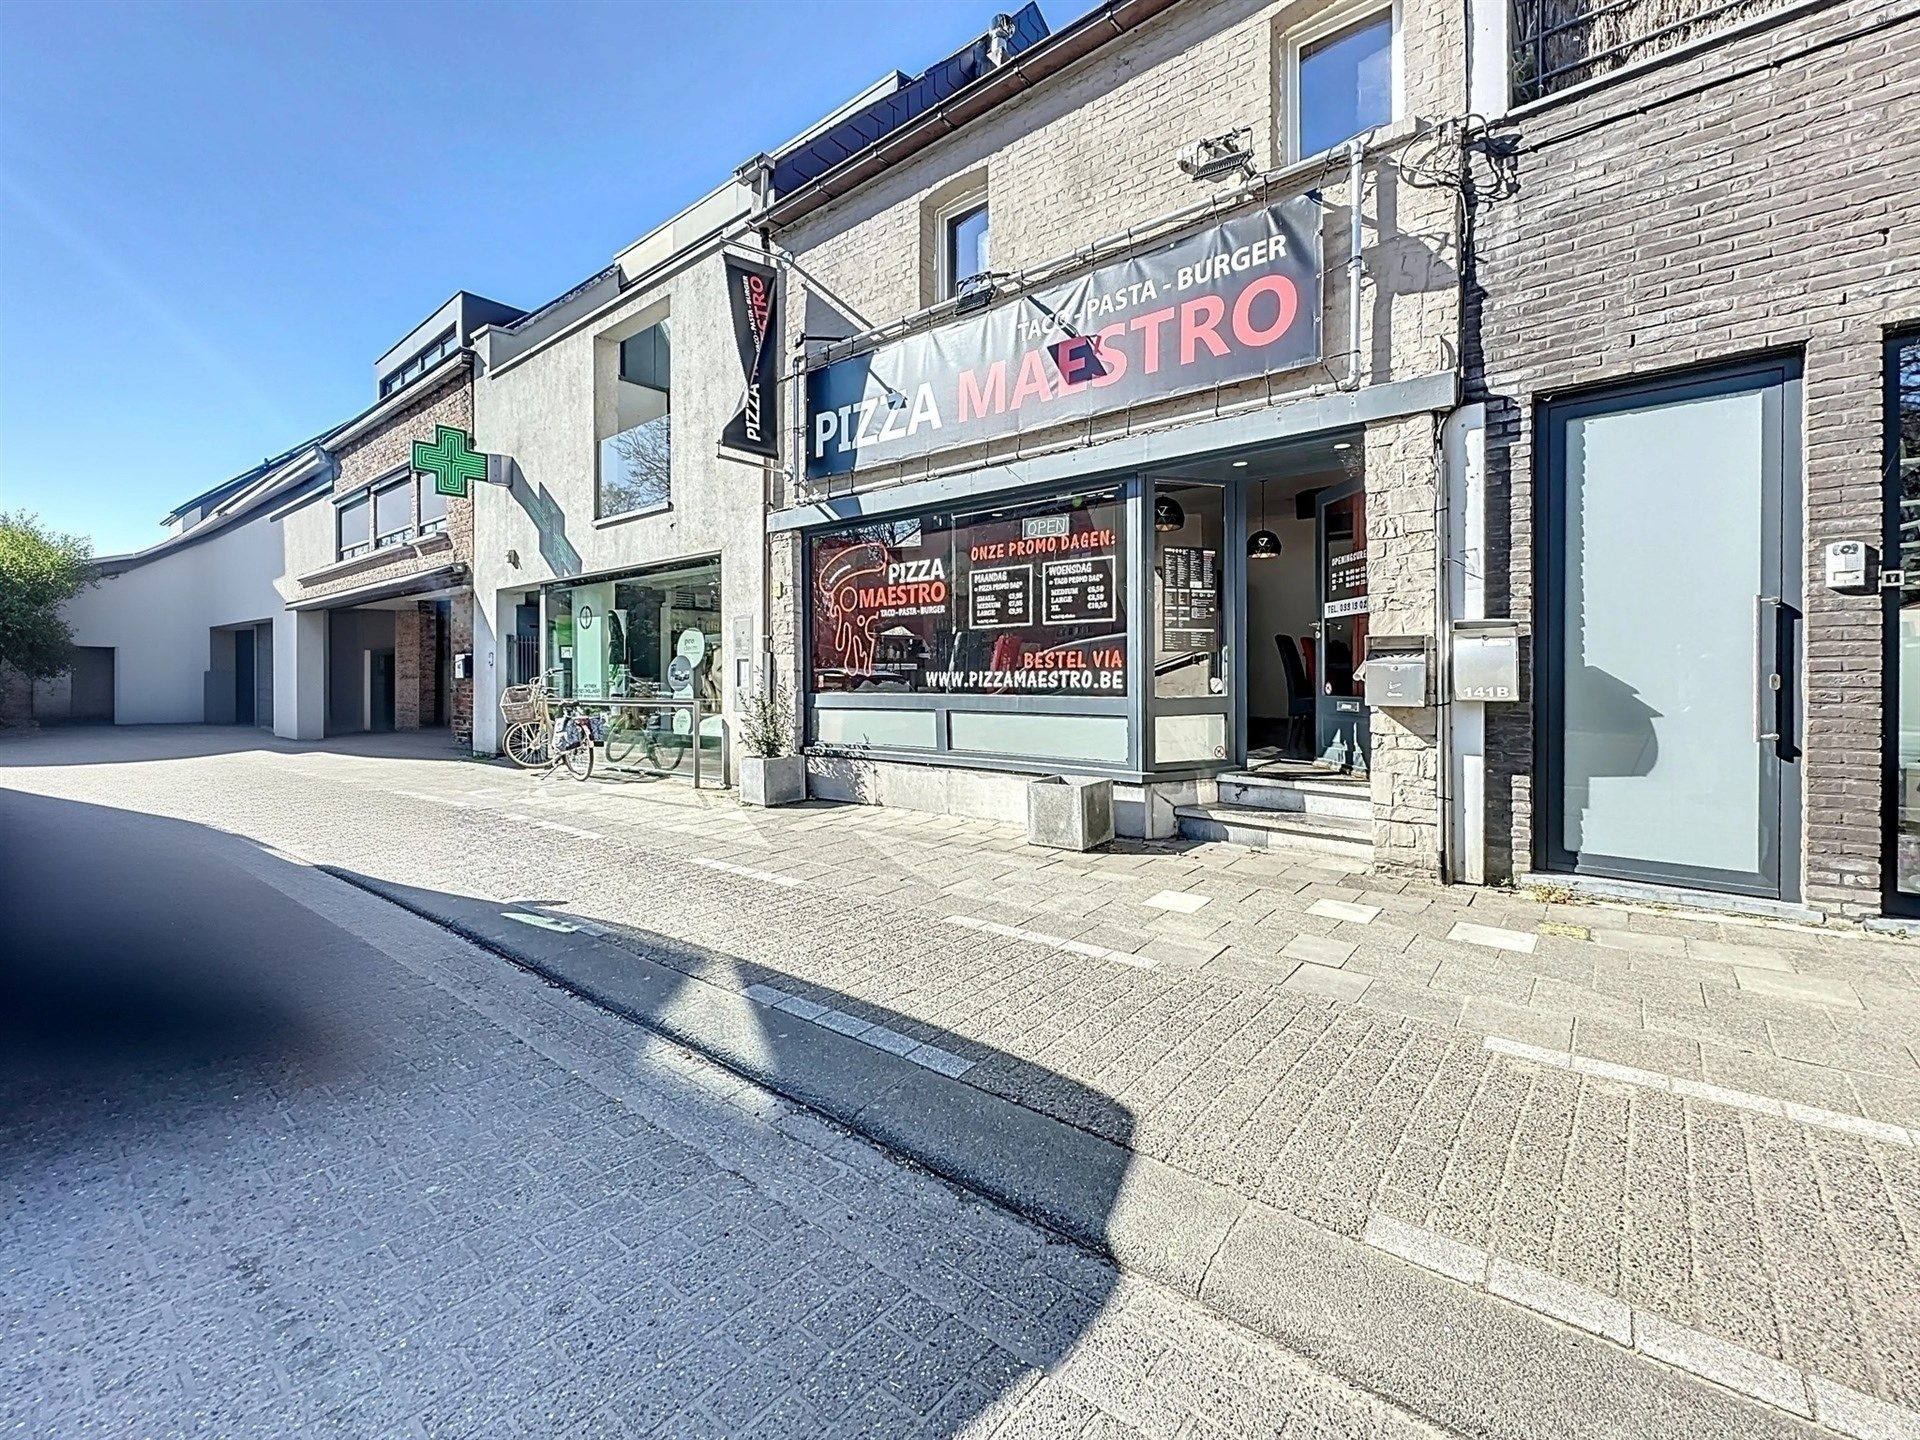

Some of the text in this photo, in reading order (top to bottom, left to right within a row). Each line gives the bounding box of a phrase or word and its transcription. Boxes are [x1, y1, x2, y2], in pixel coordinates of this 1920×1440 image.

[1087, 280, 1158, 321] PASTA
[1176, 234, 1288, 290] BURGER
[742, 275, 752, 305] BURGER
[748, 309, 757, 331] PASTA
[814, 275, 1298, 458] PIZZA MAESTRO
[745, 383, 762, 442] PIZZA
[1027, 518, 1065, 535] OPEN
[971, 529, 1116, 562] ONZE PROMO DAGEN:
[888, 557, 946, 585] PIZZA
[974, 571, 1008, 584] MAANDAG
[1048, 562, 1092, 576] WOENSDAG
[992, 582, 1009, 591] PROMO
[1053, 577, 1068, 585] TACO
[1068, 575, 1088, 584] PROMO
[859, 581, 946, 609] MAESTRO
[1050, 587, 1079, 596] MEDIUM
[1050, 595, 1073, 604] LARGE
[976, 609, 996, 617] LARGE
[1024, 649, 1122, 669] BESTEL VIA
[925, 670, 1124, 690] WWW.PIZZAMAESTRO.BE
[1463, 686, 1510, 698] 141B
